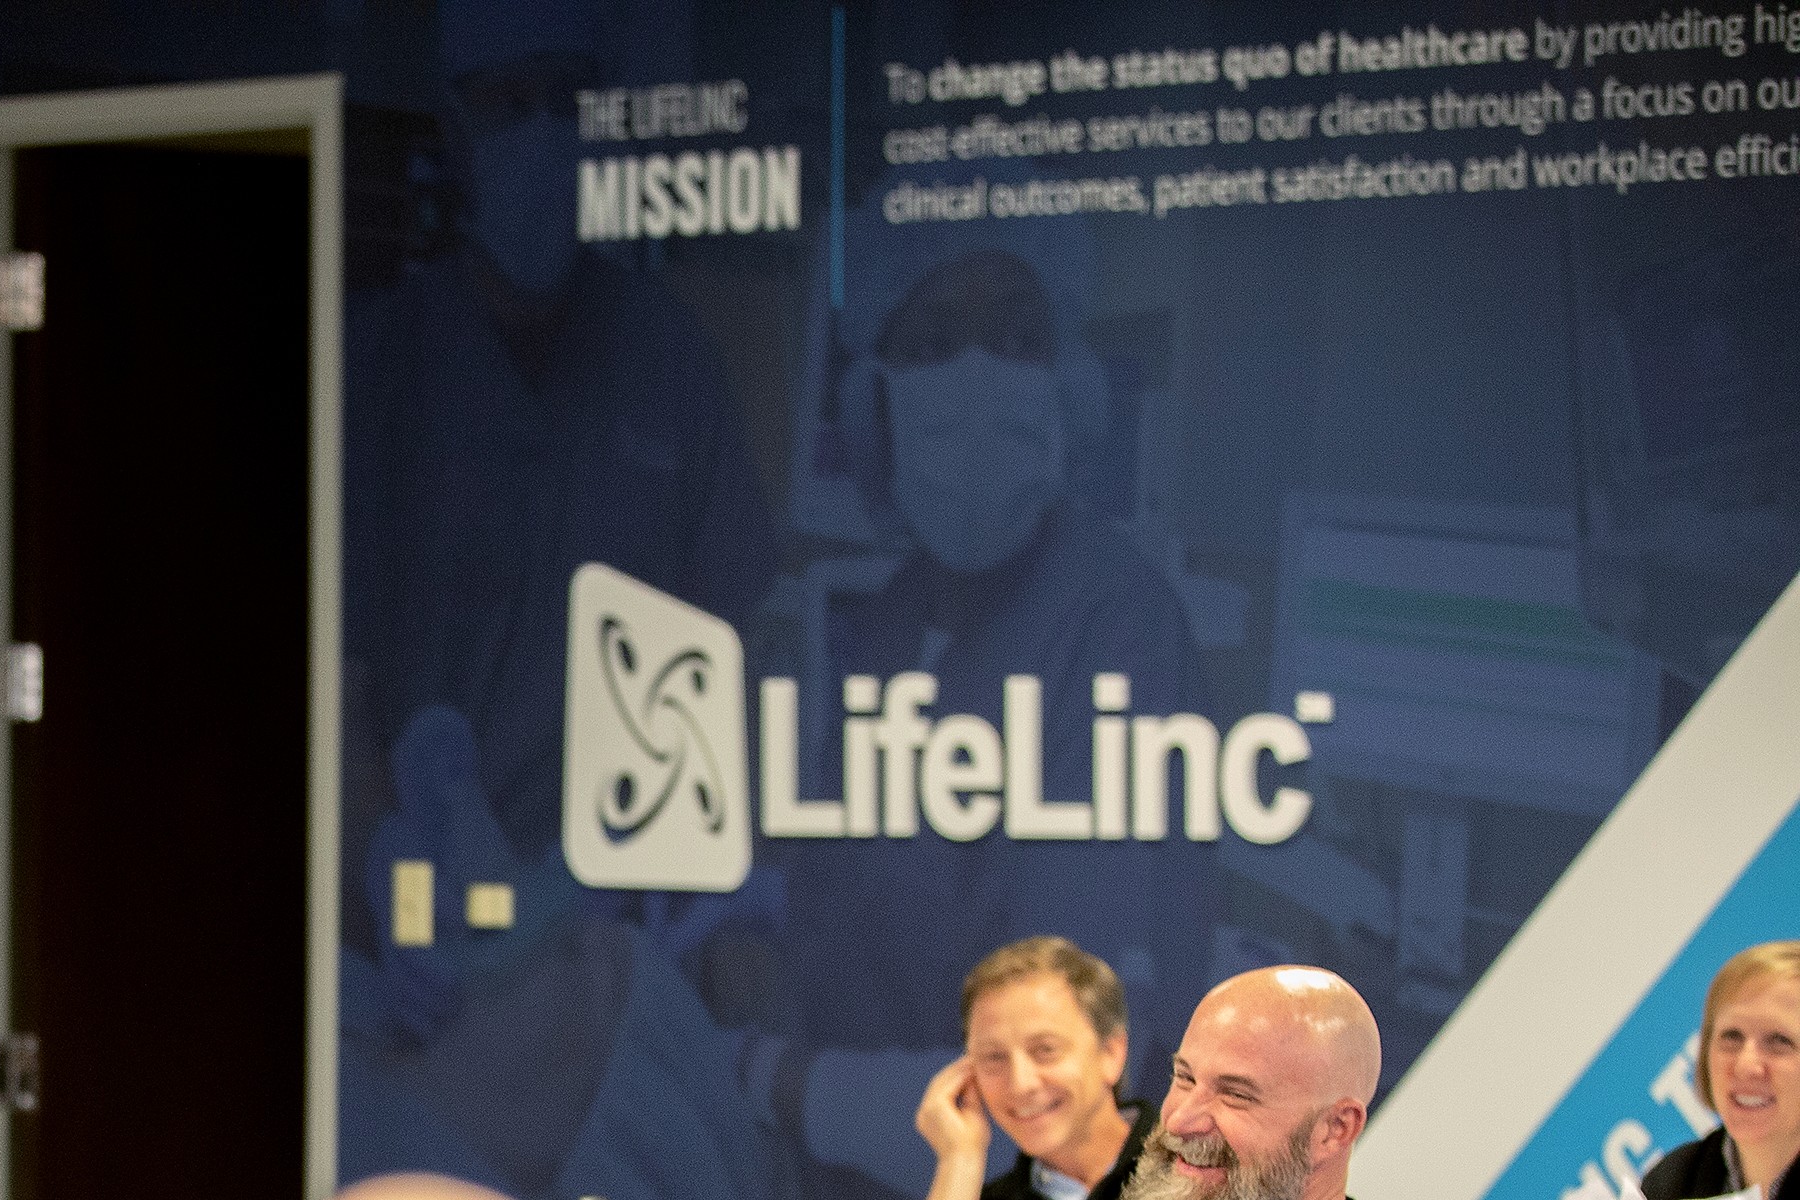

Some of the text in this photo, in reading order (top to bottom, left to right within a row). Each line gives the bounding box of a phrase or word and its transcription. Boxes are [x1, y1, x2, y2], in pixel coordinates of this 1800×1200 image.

[885, 63, 925, 104] To
[929, 57, 1045, 106] change
[1050, 49, 1107, 92] the
[1113, 48, 1217, 87] status
[1223, 44, 1290, 91] quo
[1296, 31, 1335, 76] of
[1338, 24, 1529, 72] healthcare
[1535, 17, 1577, 70] by
[1584, 9, 1747, 67] providing
[577, 79, 748, 140] THE LIFELINC
[1089, 107, 1211, 150] services
[1216, 107, 1251, 143] to
[1258, 104, 1315, 141] our
[1320, 91, 1425, 138] clients
[1432, 81, 1564, 135] through
[1572, 87, 1594, 121] a
[1602, 76, 1694, 119] focus
[1702, 79, 1748, 113] on
[579, 146, 800, 242] MISSION
[884, 178, 987, 223] clinical
[1154, 164, 1266, 219] patient
[1273, 153, 1455, 203] satisfaction
[1462, 145, 1527, 193] and
[1533, 140, 1707, 195] workplace
[760, 672, 1313, 844] LifeLinc
